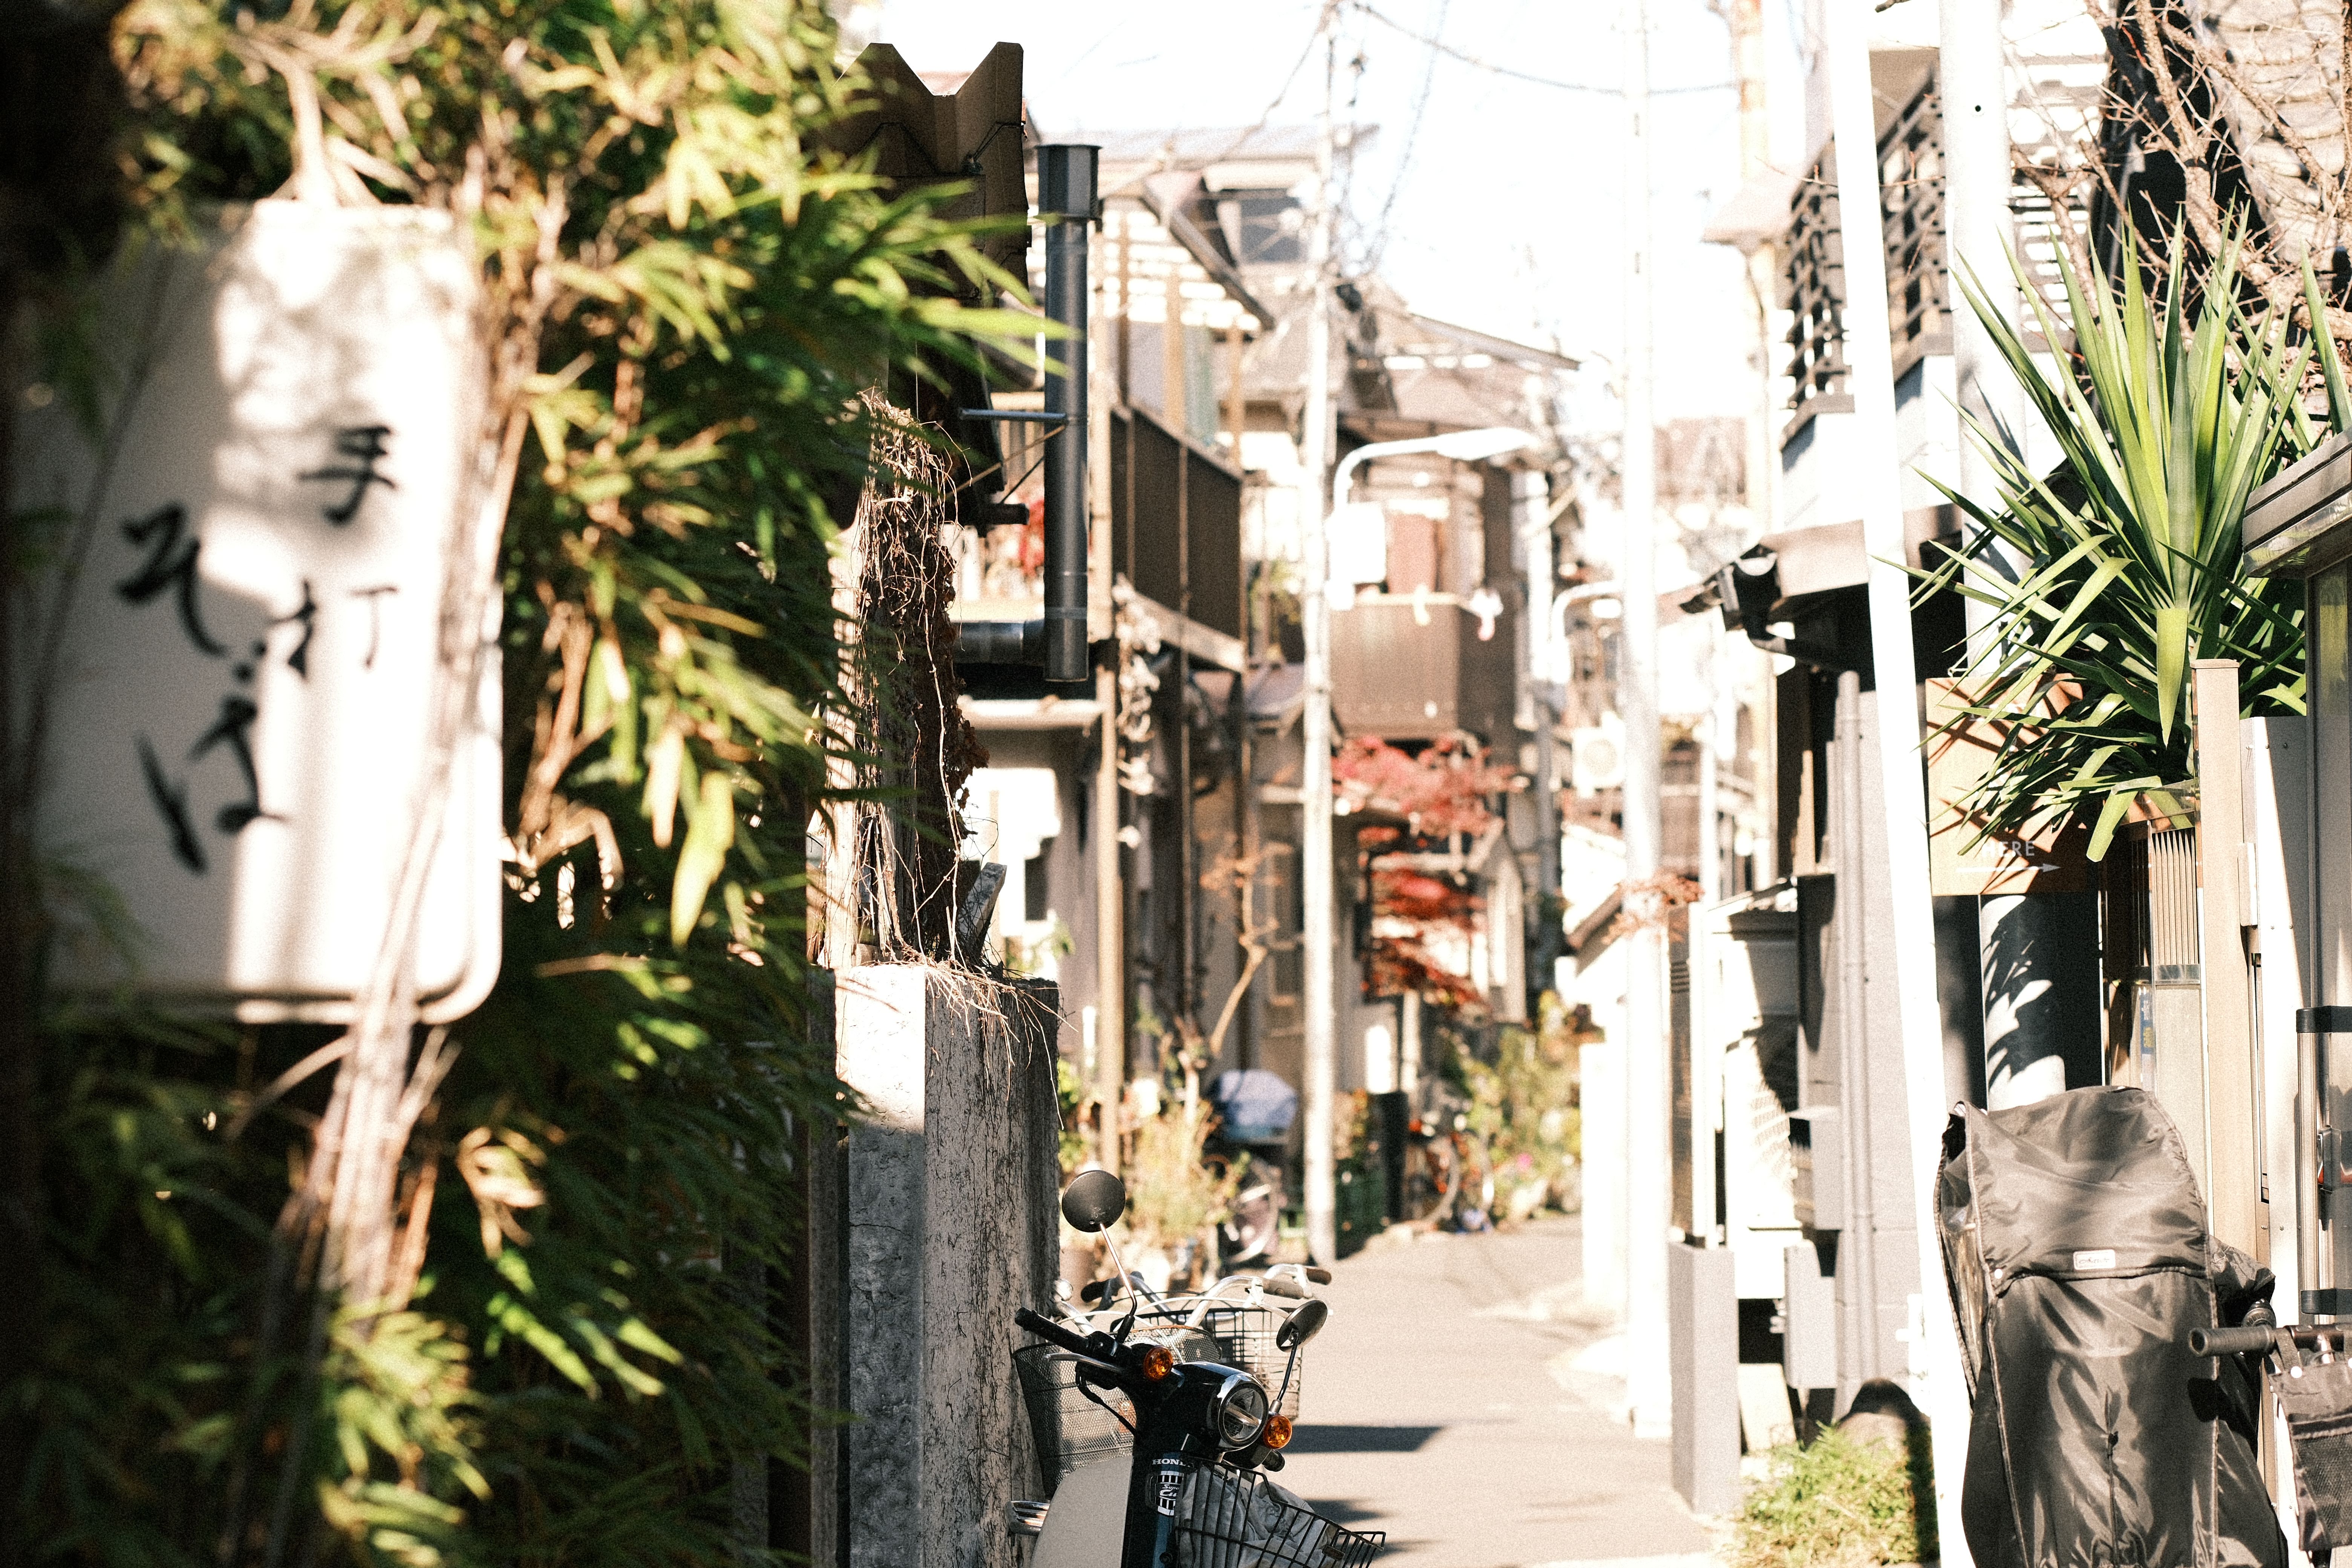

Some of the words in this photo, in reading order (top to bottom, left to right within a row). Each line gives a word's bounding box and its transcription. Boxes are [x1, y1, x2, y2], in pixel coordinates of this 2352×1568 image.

[114, 501, 292, 874] そば
[1981, 840, 2035, 858] HERE
[1152, 1458, 1190, 1467] HON
